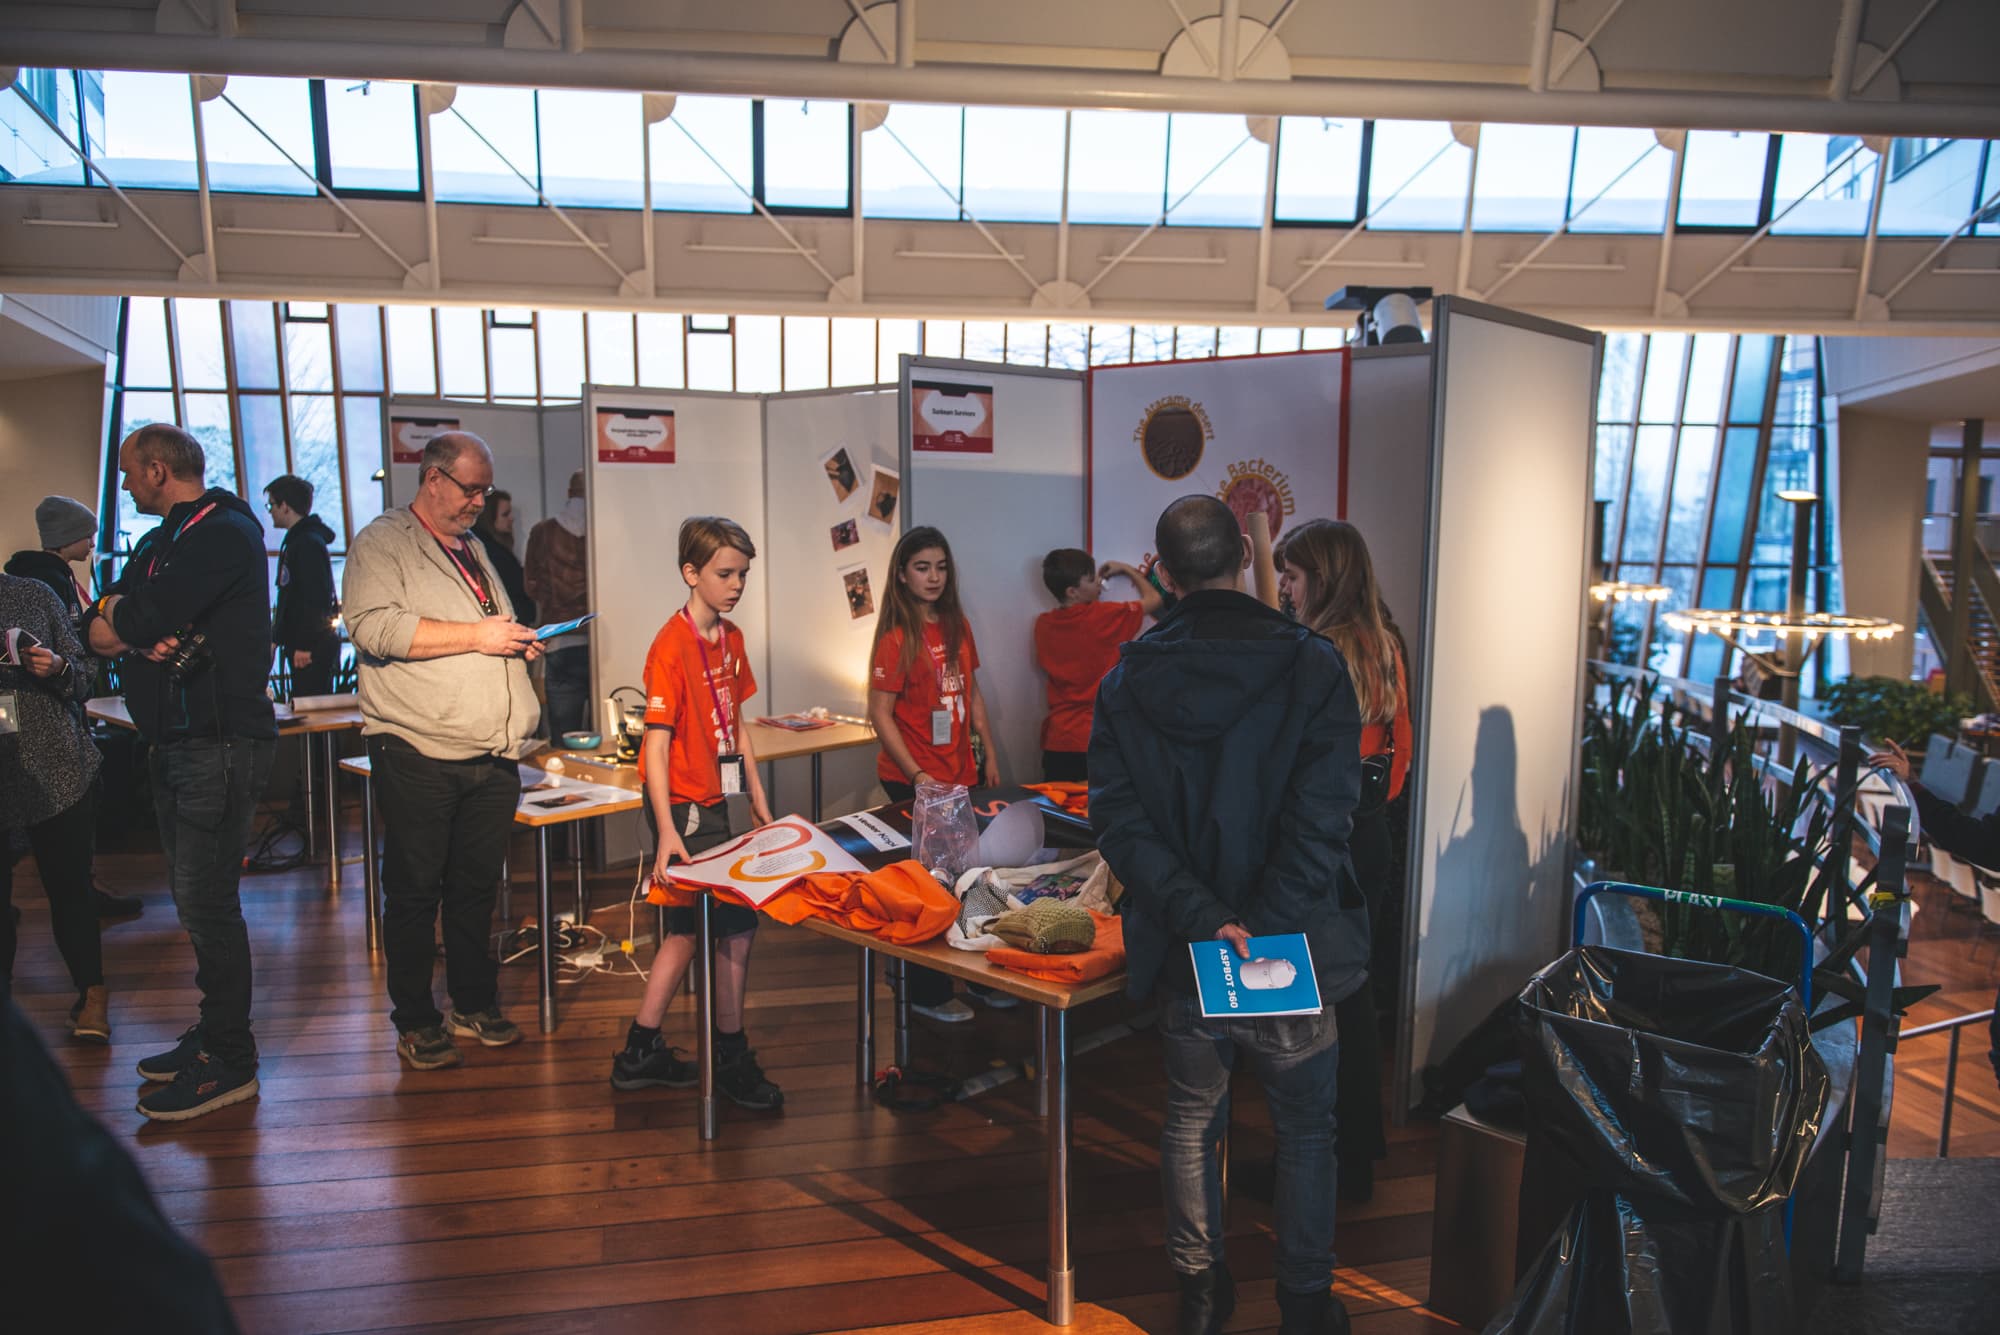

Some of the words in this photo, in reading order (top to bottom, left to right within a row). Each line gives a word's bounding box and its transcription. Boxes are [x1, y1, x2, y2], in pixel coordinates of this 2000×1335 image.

[1133, 418, 1145, 442] The
[1192, 401, 1215, 440] desert
[1227, 457, 1296, 516] Bacterium
[878, 832, 898, 847] Kopi
[1219, 948, 1234, 987] ASPBOT
[1228, 990, 1238, 1008] 360
